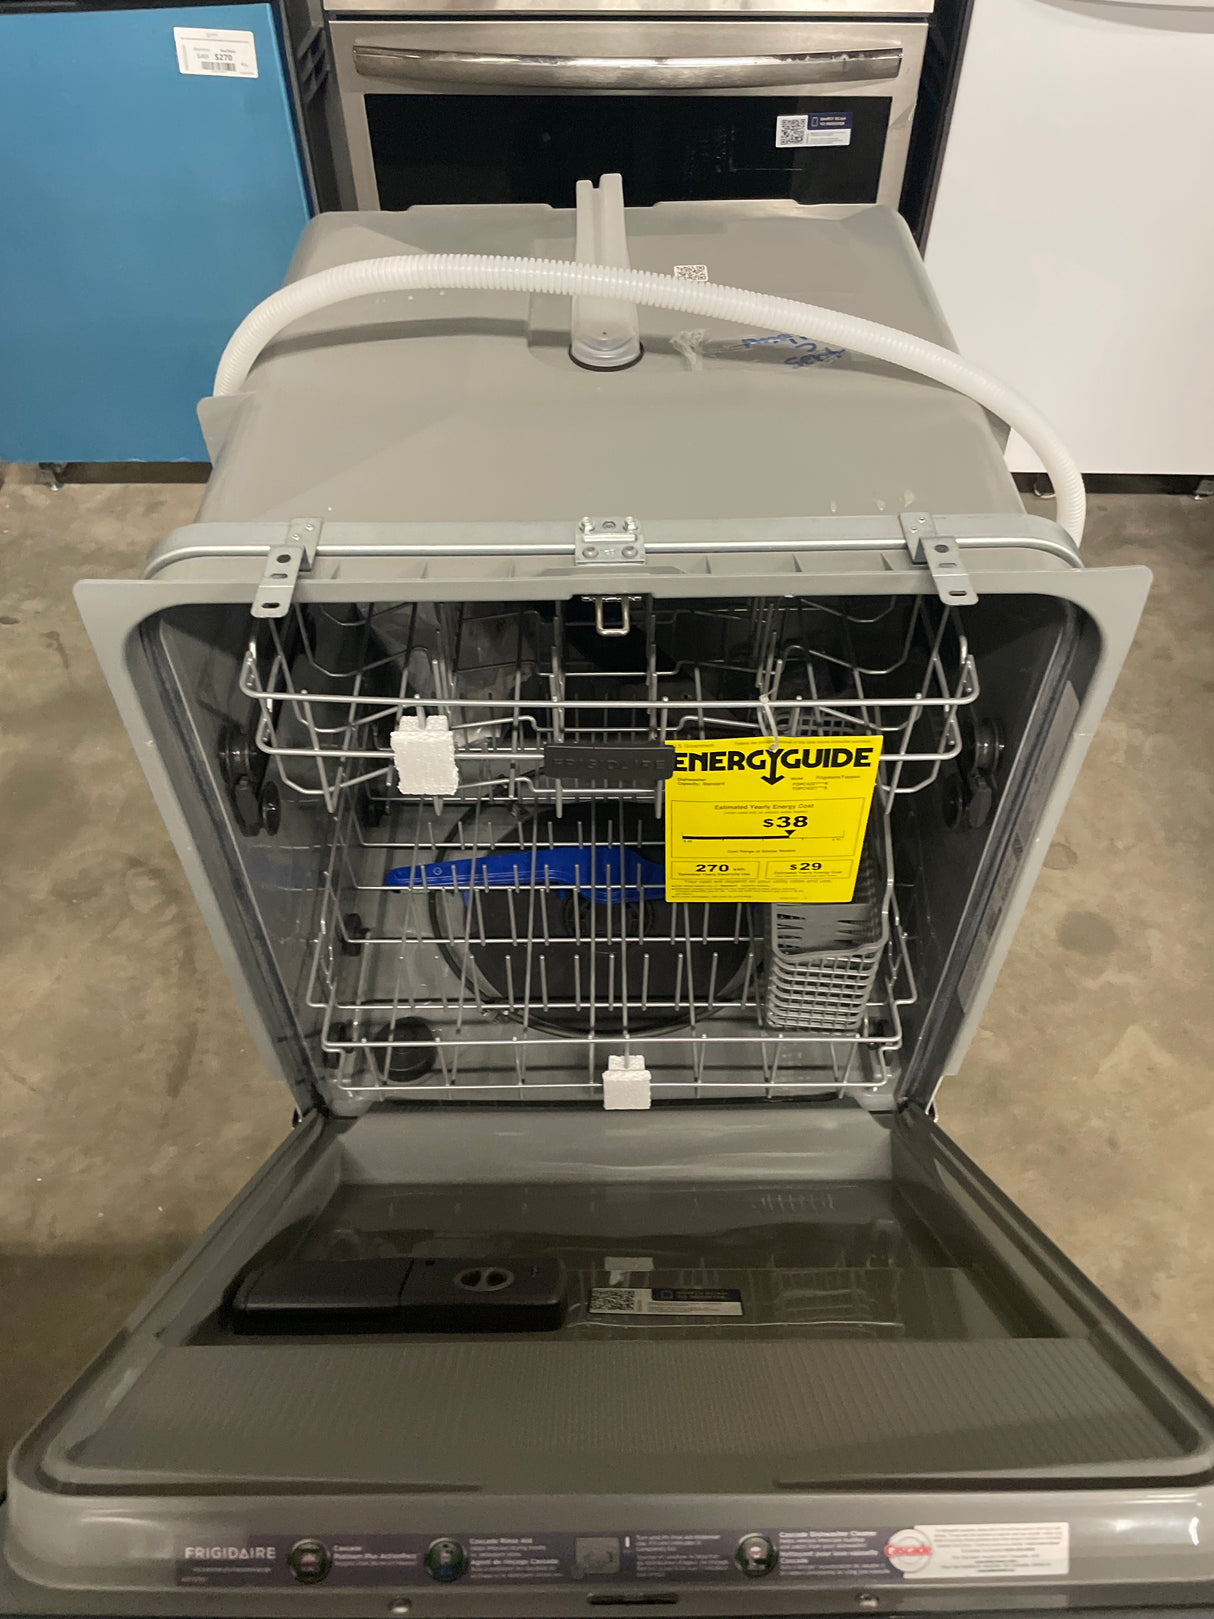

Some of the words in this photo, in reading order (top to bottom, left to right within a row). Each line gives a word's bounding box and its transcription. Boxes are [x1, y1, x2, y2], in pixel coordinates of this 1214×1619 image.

[673, 748, 874, 778] ENERGYGUIDE
[763, 816, 808, 828] $38
[696, 864, 729, 872] 270
[790, 862, 822, 871] $29
[184, 1546, 276, 1559] FRIGIDAIRE
